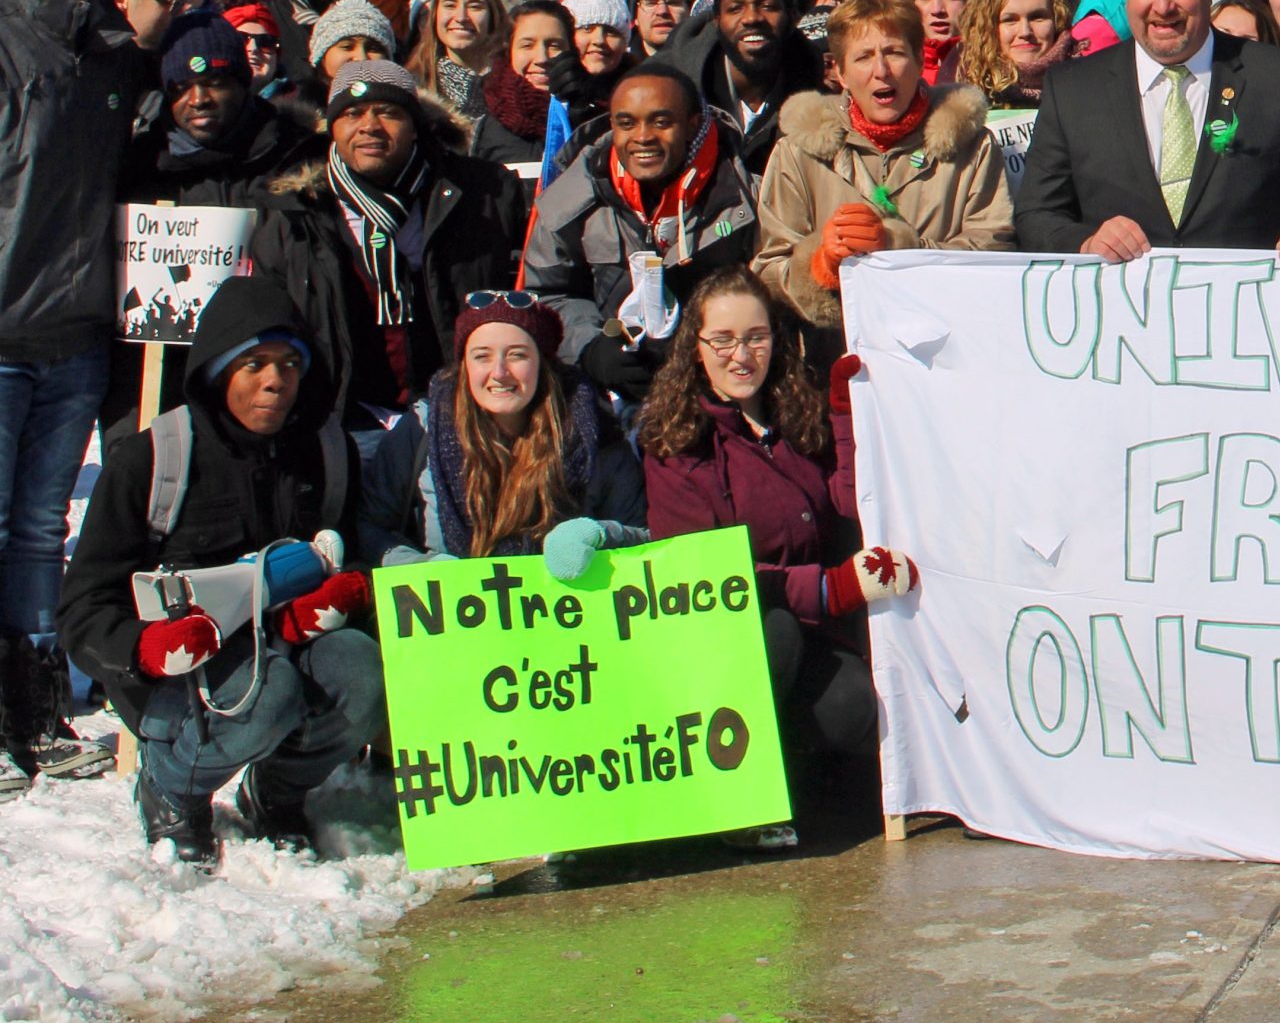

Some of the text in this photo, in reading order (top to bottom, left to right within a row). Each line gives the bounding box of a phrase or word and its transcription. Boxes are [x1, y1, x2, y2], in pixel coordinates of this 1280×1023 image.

[137, 213, 200, 236] On veut
[116, 241, 147, 263] OTRE
[152, 243, 233, 267] université
[391, 560, 750, 641] Notre place
[395, 706, 750, 819] #UniversitéFO
